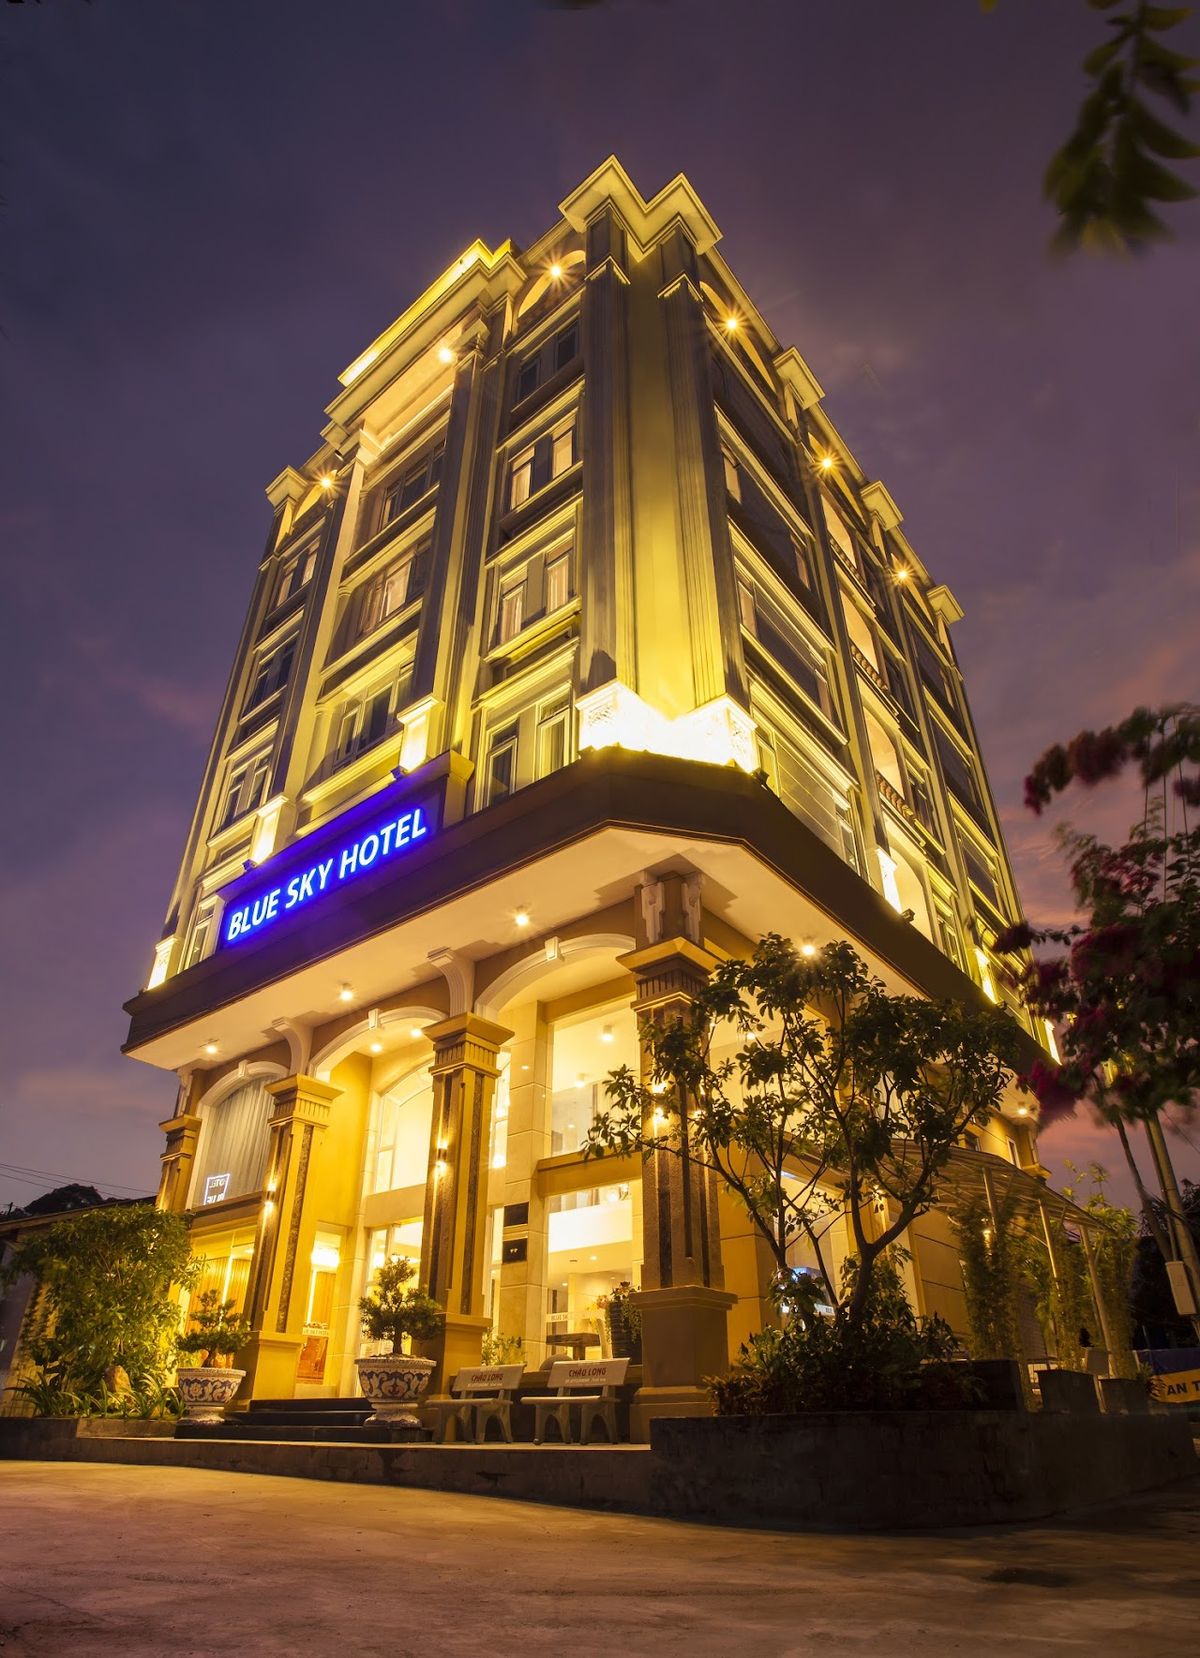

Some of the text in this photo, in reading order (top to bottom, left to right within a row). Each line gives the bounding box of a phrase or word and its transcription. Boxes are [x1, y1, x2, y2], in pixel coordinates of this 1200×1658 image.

[227, 808, 427, 941] BLUE SKY HOTEL
[588, 1367, 606, 1376] LONG
